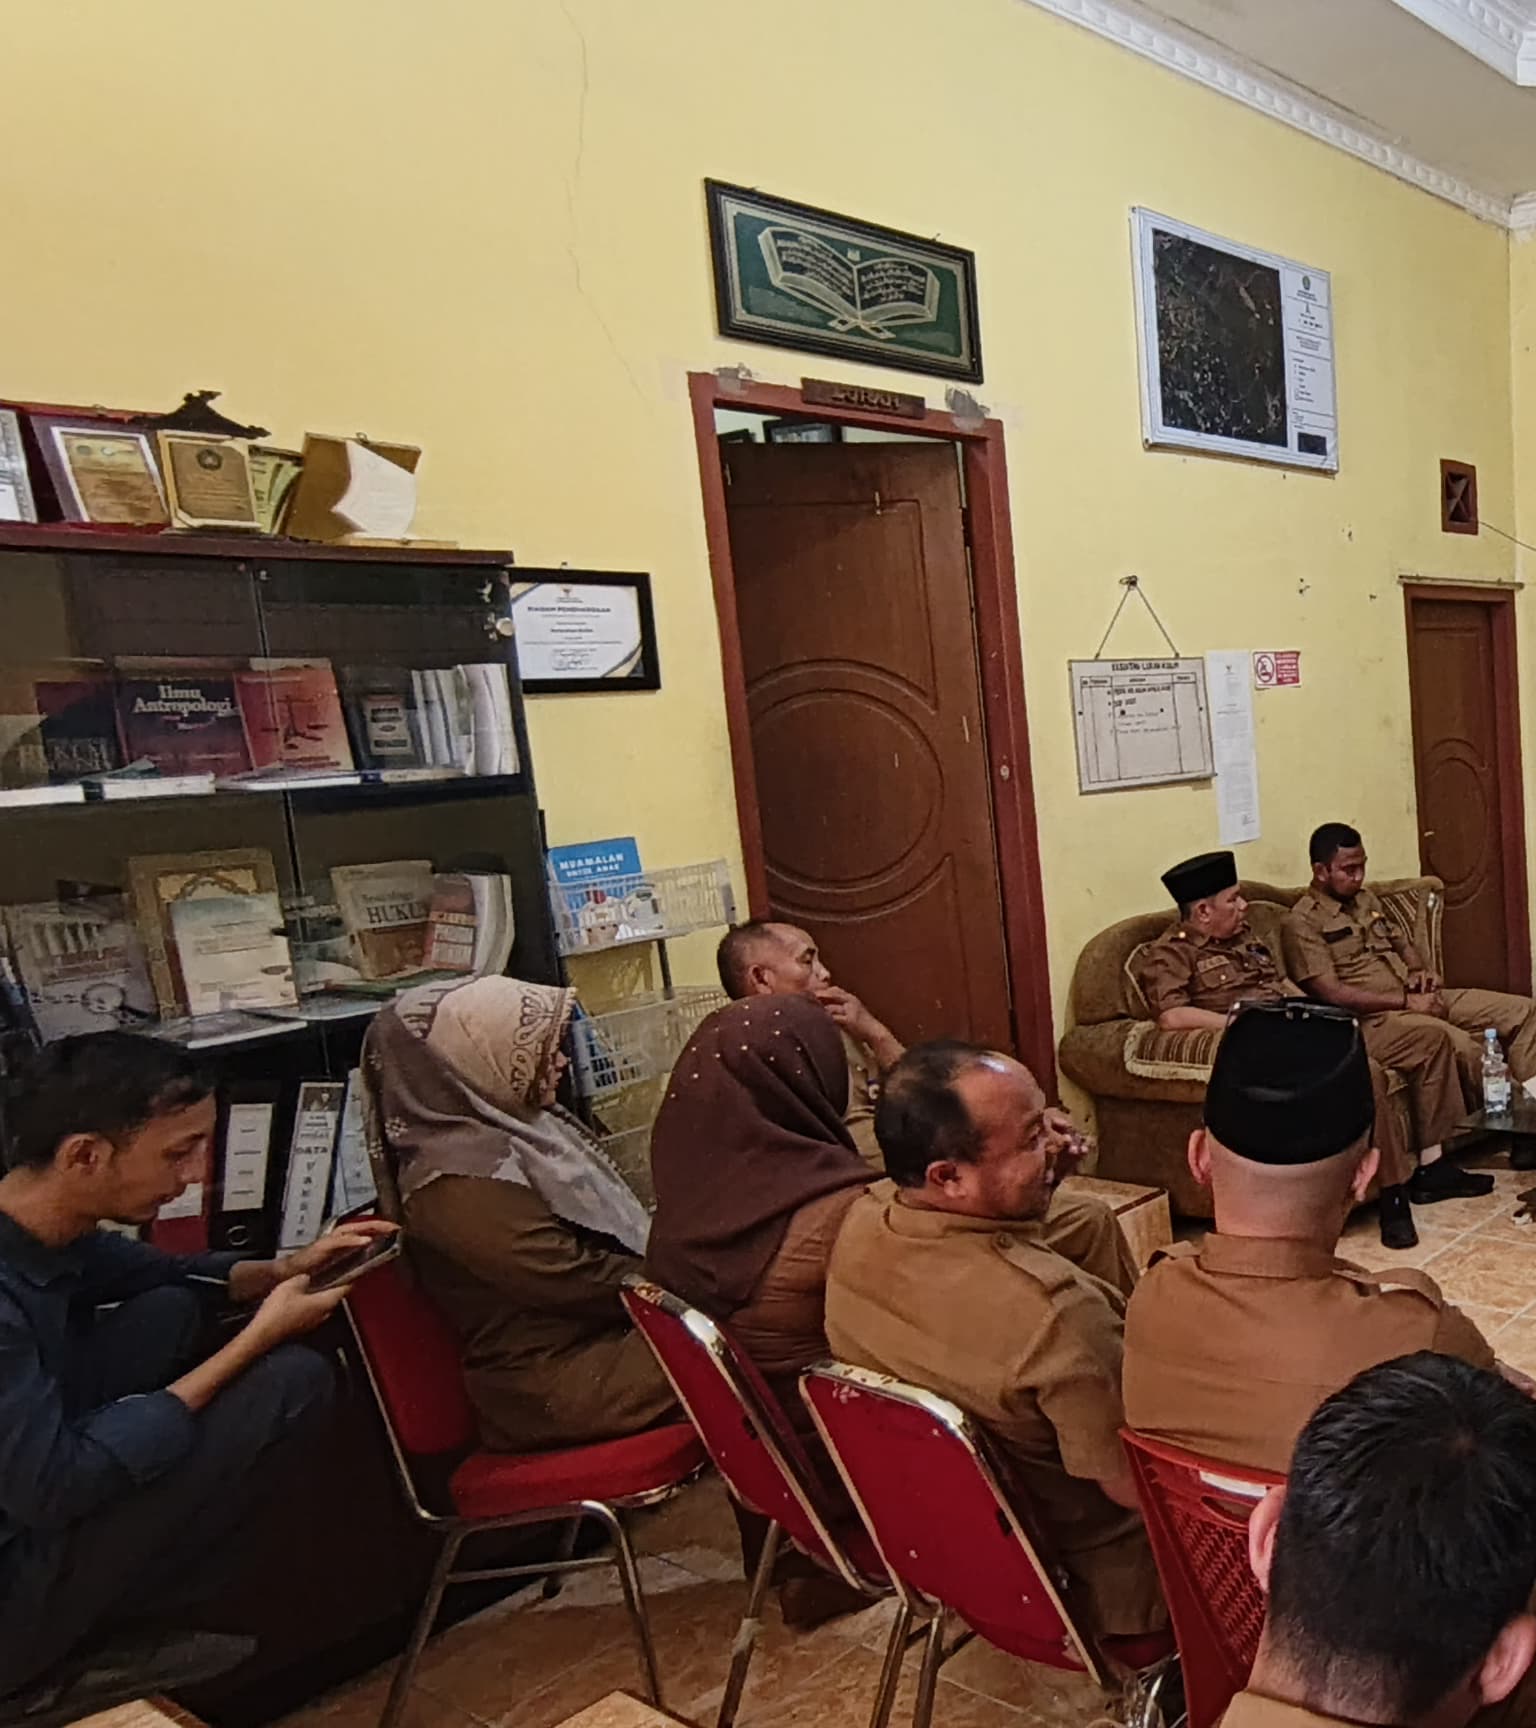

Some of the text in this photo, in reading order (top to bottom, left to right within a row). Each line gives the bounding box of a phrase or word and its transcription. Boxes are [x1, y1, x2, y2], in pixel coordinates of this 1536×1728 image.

[158, 684, 202, 700] Ilmu
[133, 696, 233, 717] Antropologi
[367, 901, 428, 924] HUKU
